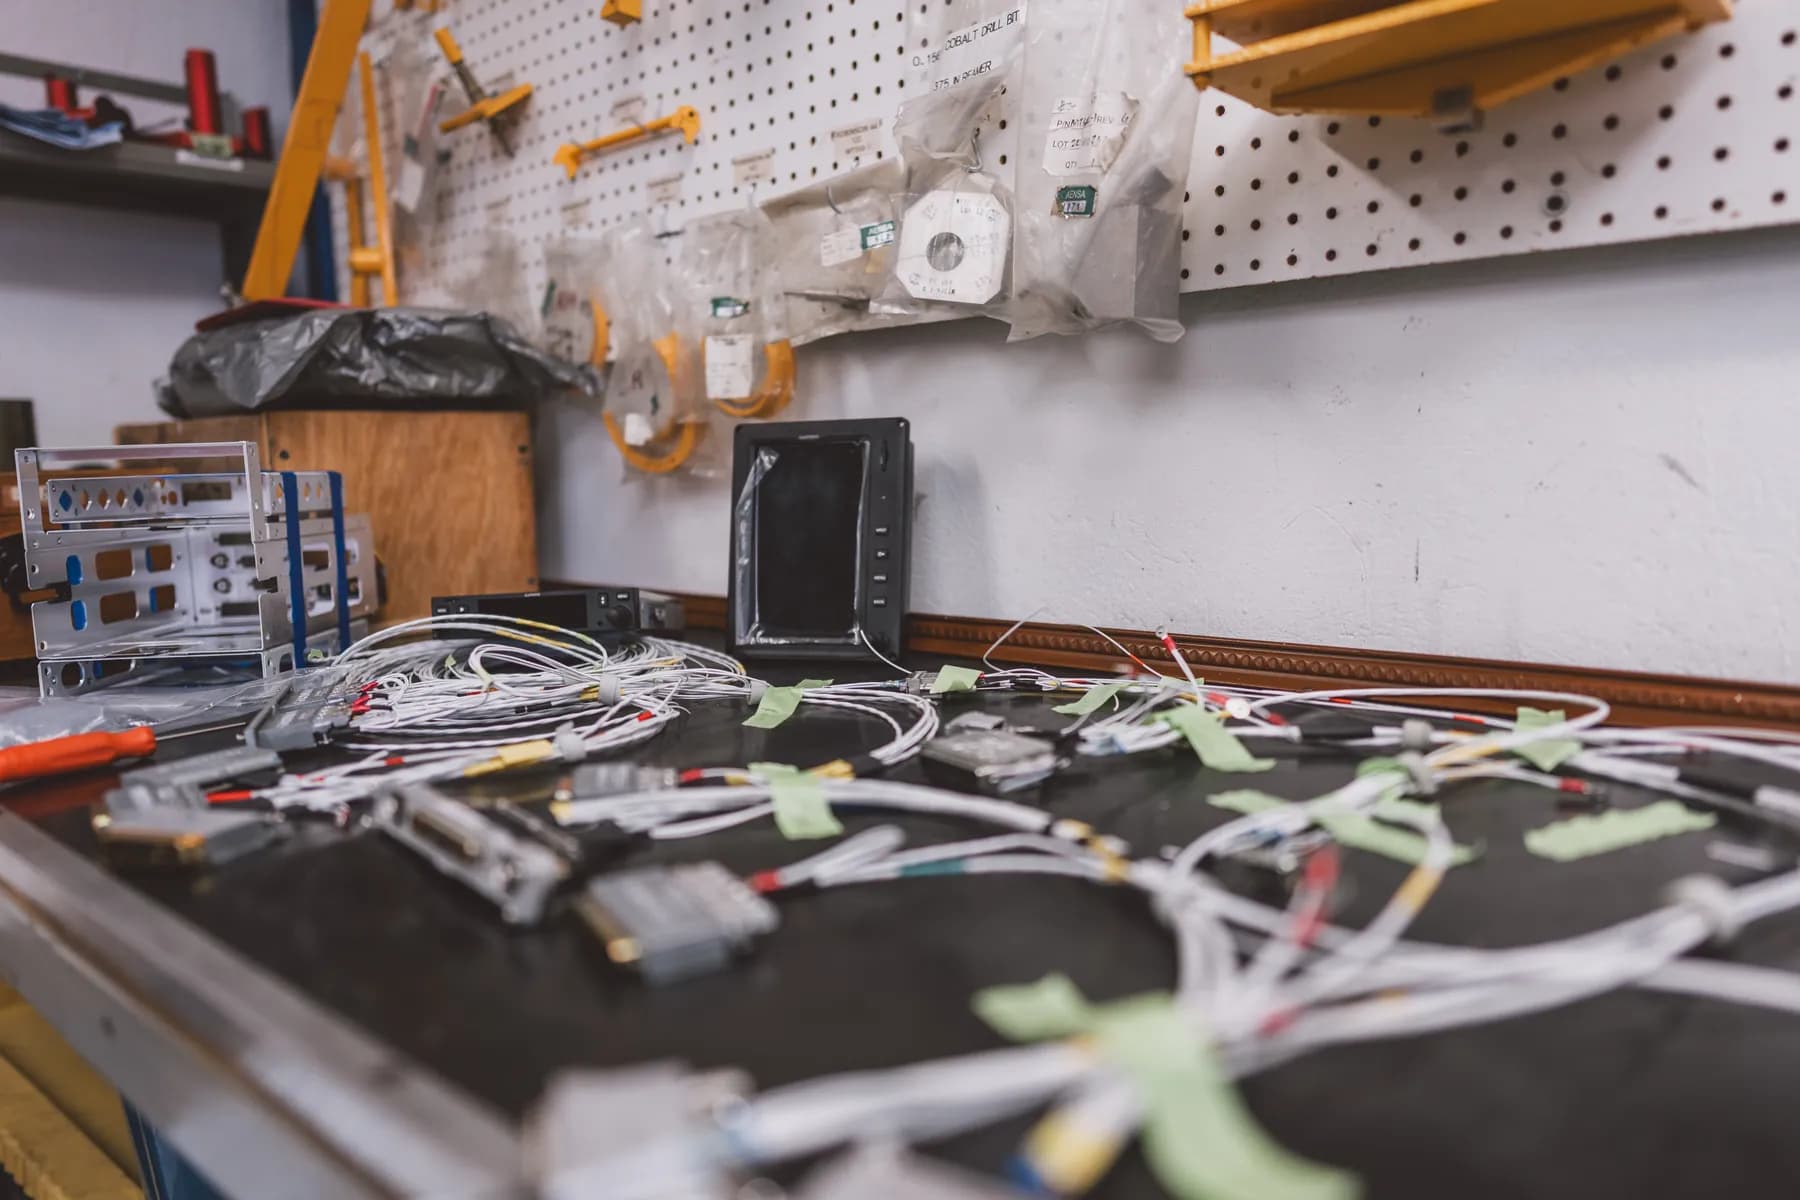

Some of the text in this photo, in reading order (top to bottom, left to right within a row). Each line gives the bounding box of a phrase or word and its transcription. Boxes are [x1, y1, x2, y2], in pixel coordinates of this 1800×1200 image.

[944, 30, 979, 51] COBALT
[981, 19, 1003, 37] DRILL
[1006, 9, 1020, 26] BIT
[1052, 140, 1069, 149] LOT
